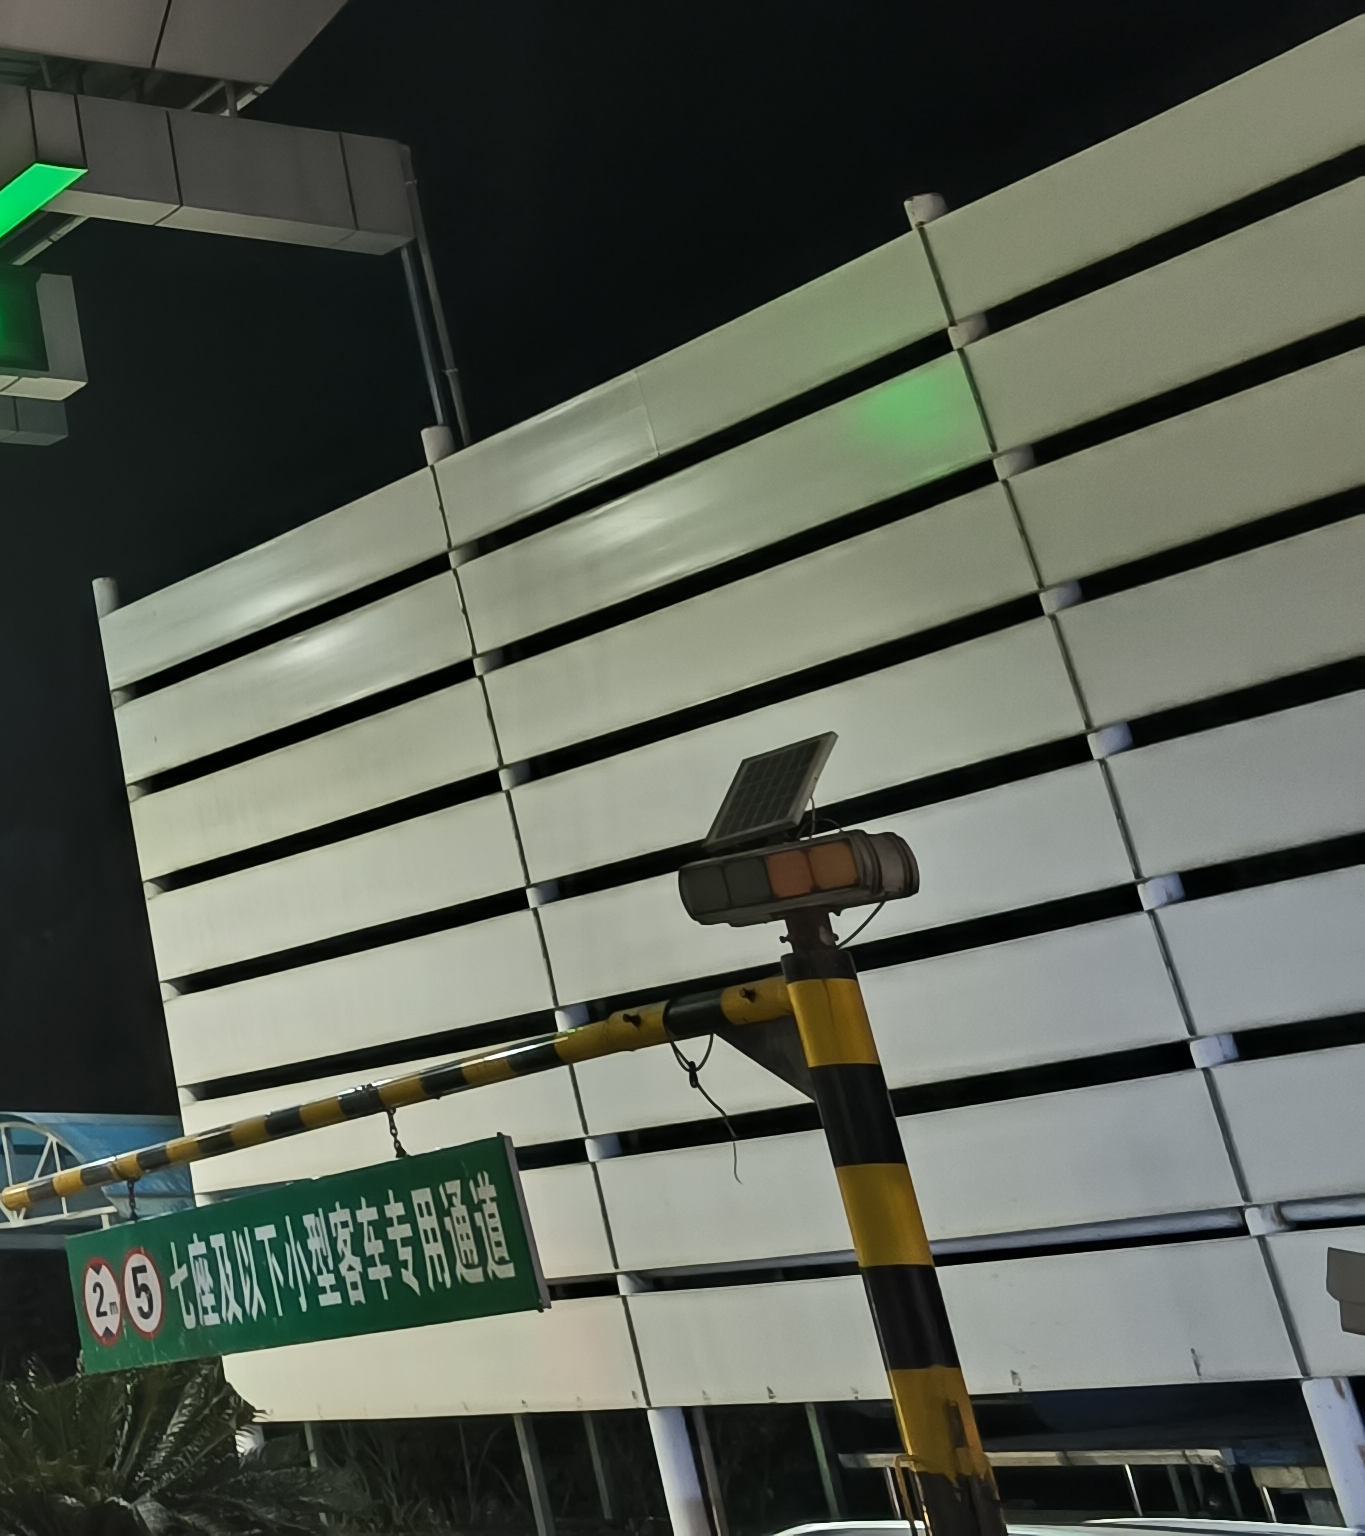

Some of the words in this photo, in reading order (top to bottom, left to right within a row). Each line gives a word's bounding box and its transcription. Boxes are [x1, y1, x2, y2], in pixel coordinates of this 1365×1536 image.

[169, 1170, 516, 1330] 七座及以下小型客车专用通道
